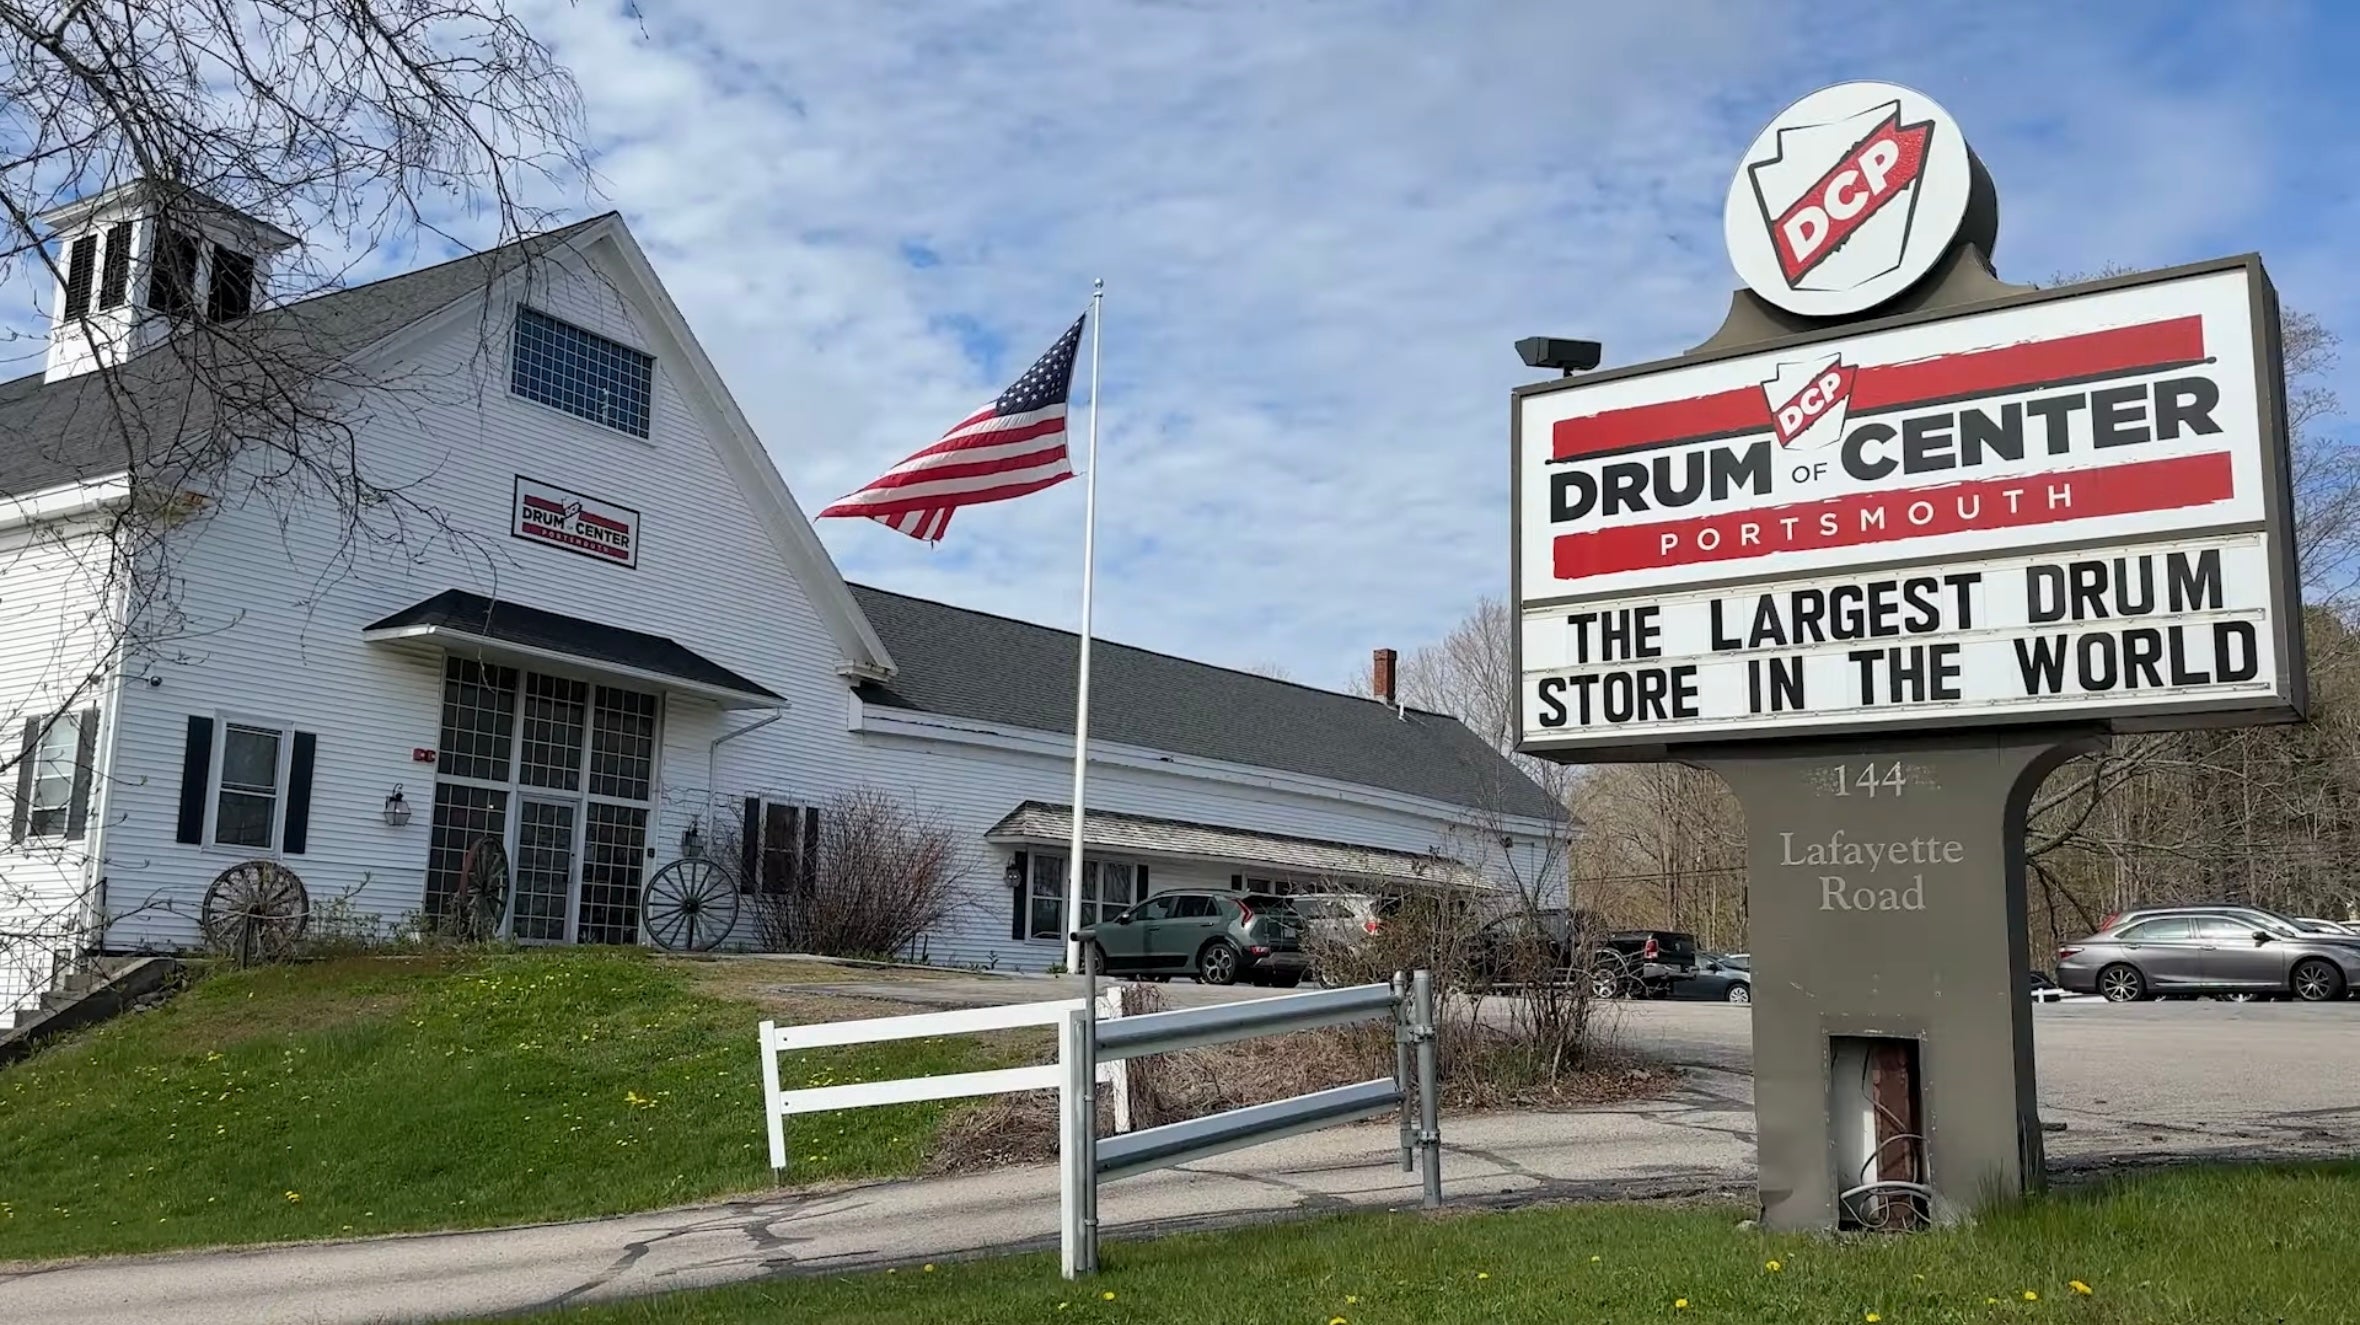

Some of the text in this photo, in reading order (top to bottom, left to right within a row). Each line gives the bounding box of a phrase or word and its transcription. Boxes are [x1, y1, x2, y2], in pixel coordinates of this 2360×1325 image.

[1783, 139, 1900, 263] DCP
[1778, 372, 1842, 436] DCP
[1551, 376, 2224, 523] DRUM OF CENTER
[522, 506, 565, 529] DRUM
[575, 522, 630, 548] CENTER
[541, 529, 609, 553] PORTSMOUTH
[1661, 483, 2073, 556] PORTSMOUTH
[1568, 549, 2223, 664] THE LARGEST DRUM
[1538, 620, 2259, 727] STORE IN THE WORLD
[1834, 761, 1906, 798] 144
[1779, 829, 1965, 873] Lafayette
[1818, 873, 1926, 911] Road
